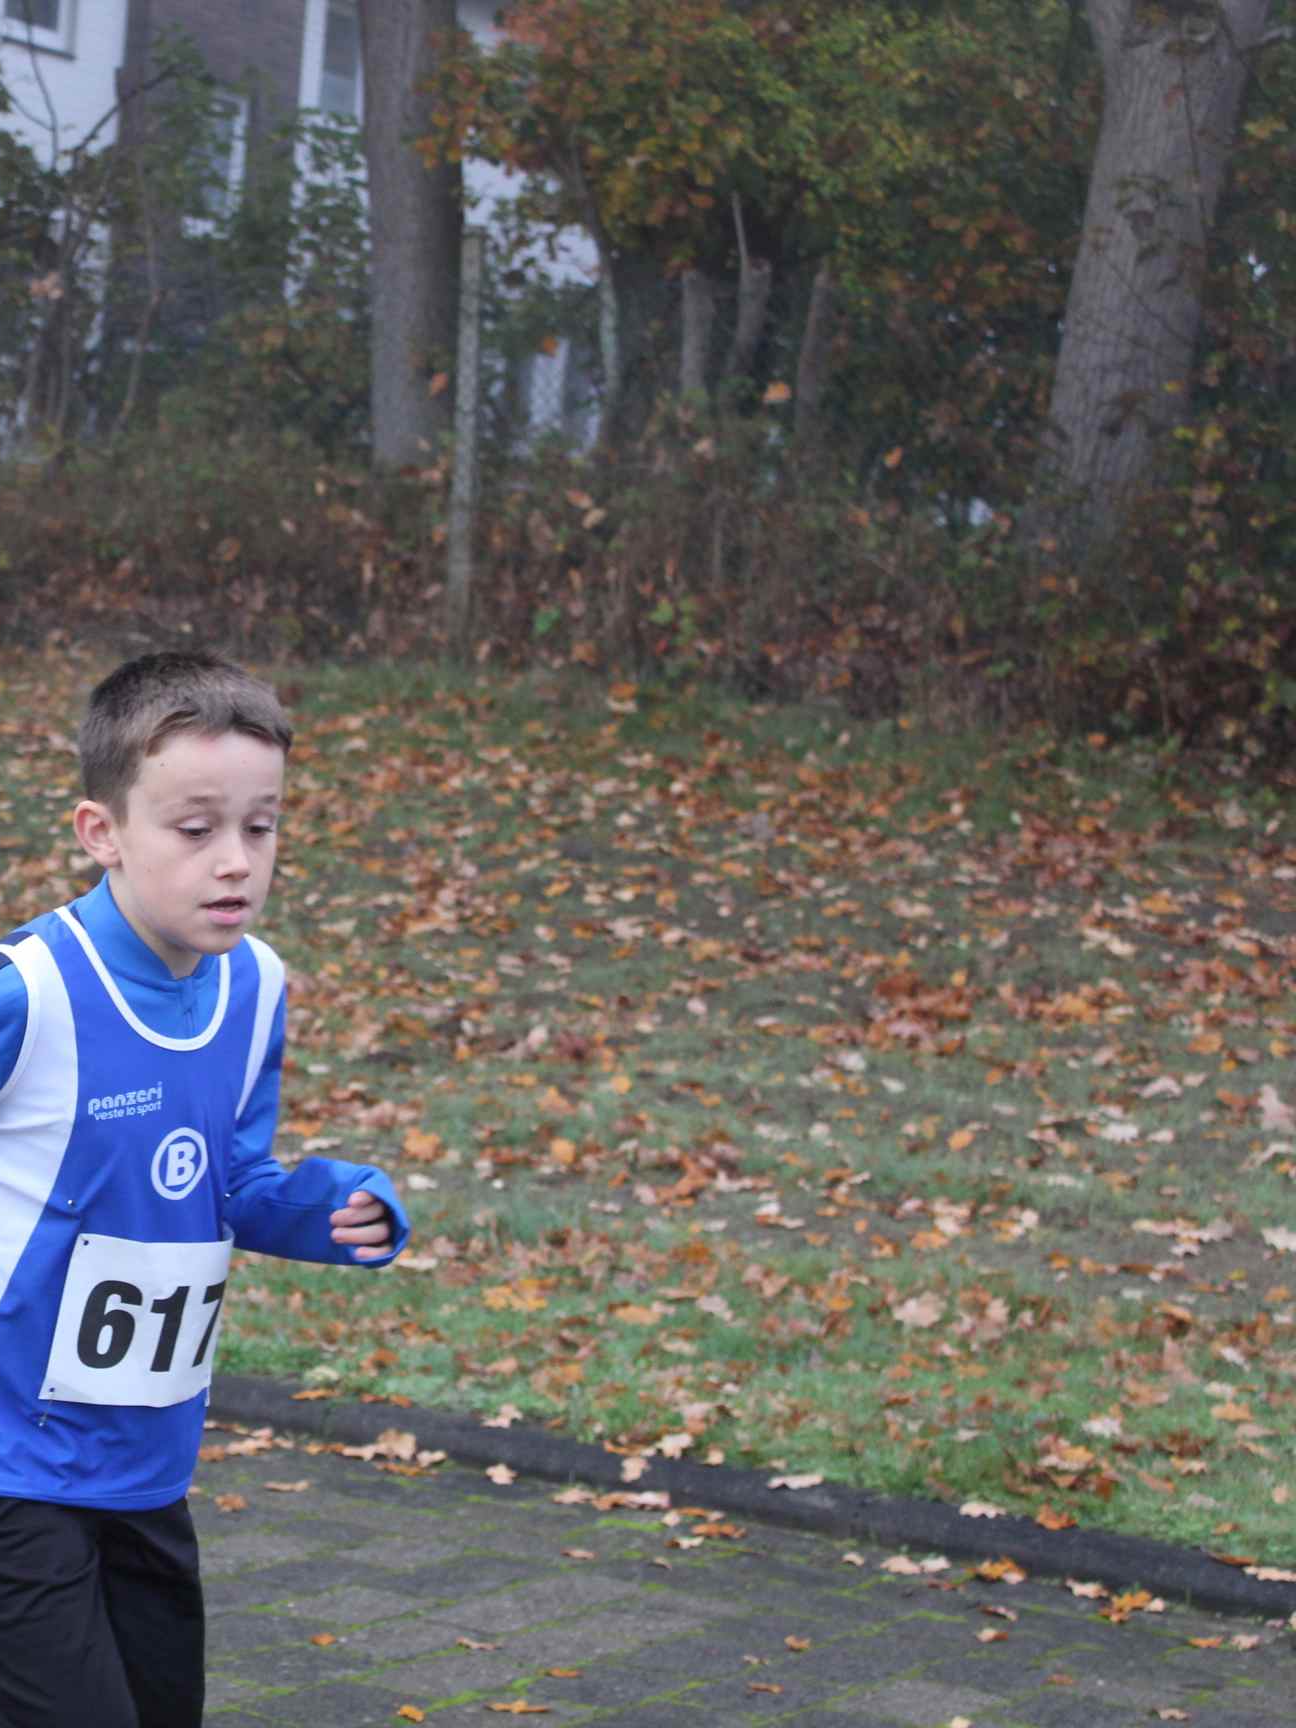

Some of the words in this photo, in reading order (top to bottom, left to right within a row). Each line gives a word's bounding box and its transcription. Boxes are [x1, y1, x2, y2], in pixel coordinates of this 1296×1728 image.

[88, 1081, 163, 1115] panzeri
[94, 1107, 124, 1121] veste
[126, 1105, 136, 1115] lo
[137, 1100, 162, 1117] sport
[165, 1141, 197, 1187] B
